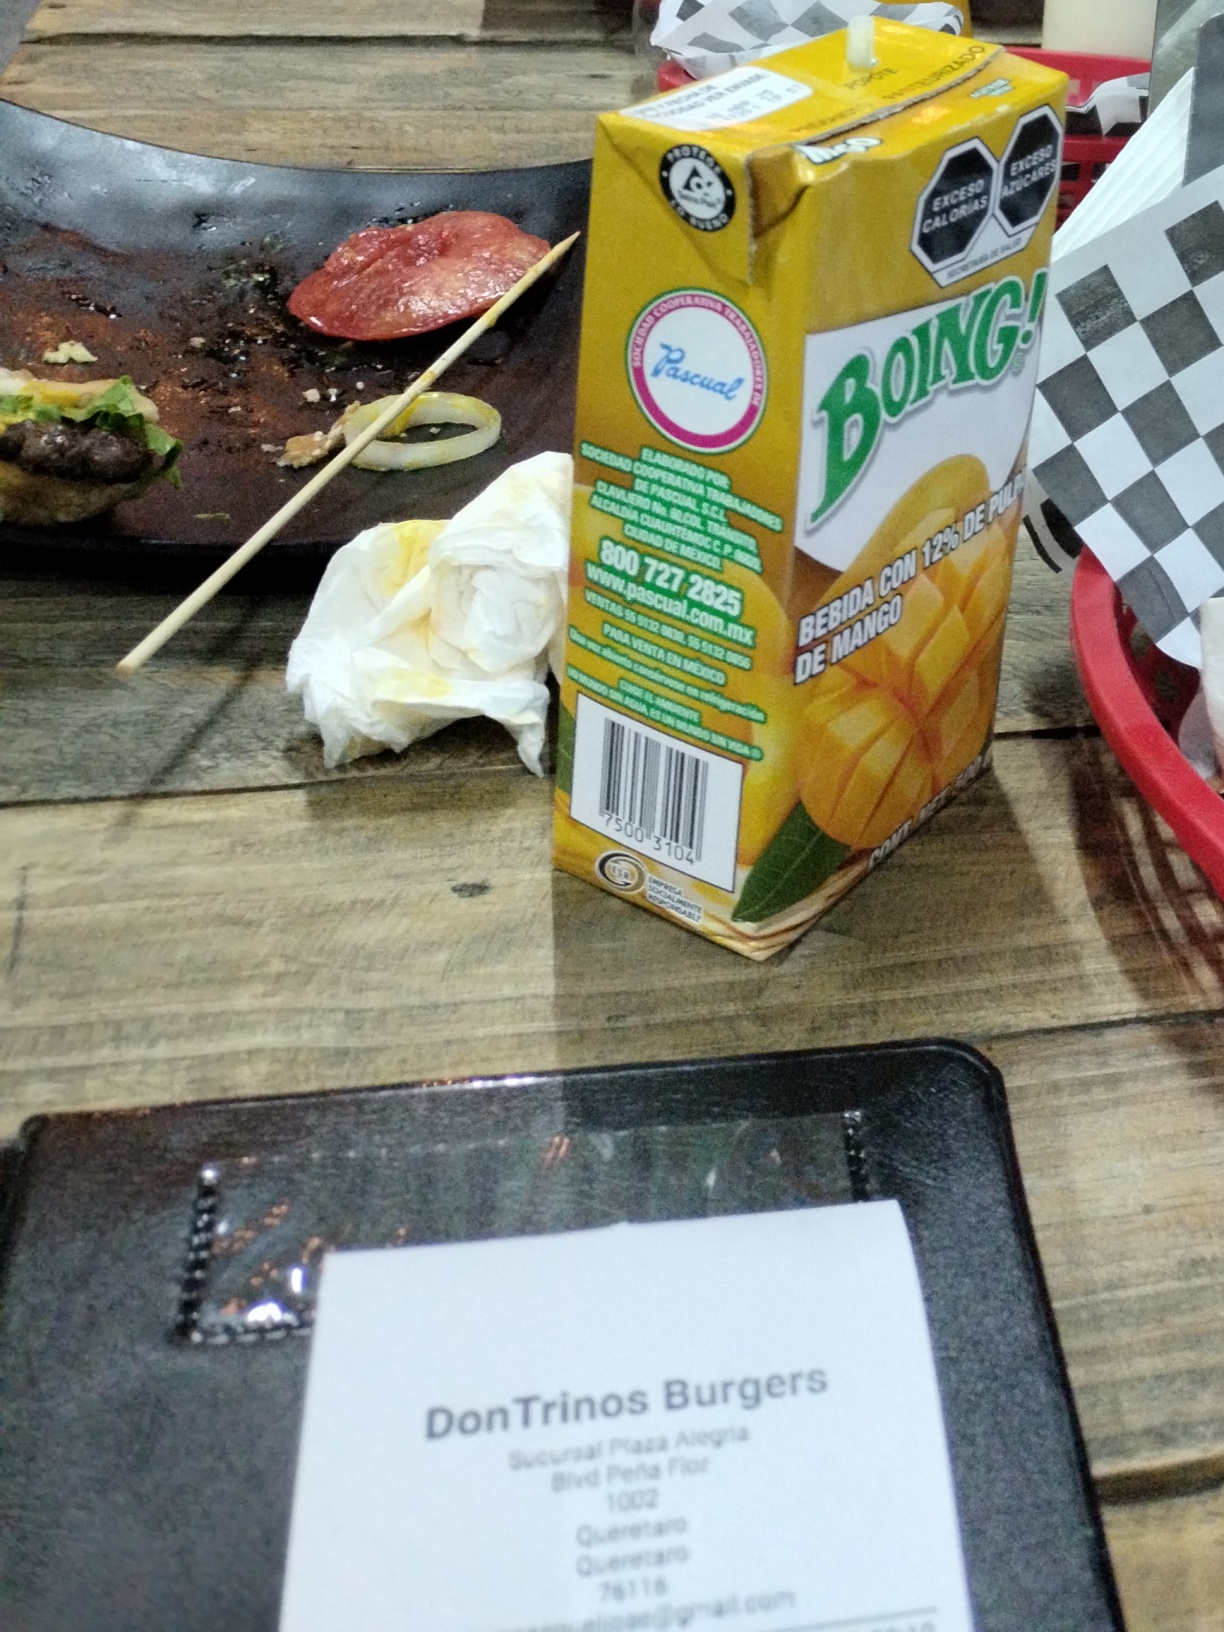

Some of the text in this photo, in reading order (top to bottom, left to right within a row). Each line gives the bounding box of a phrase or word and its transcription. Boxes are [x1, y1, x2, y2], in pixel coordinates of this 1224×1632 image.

[1001, 158, 1058, 197] AZÚCARES
[1010, 144, 1053, 176] EXCESO
[922, 195, 989, 234] CALORÍAS
[932, 179, 985, 212] EXCESO
[650, 342, 745, 401] Pascual
[809, 268, 1049, 524] BOING!
[581, 442, 632, 473] SOCIEDAD
[600, 537, 743, 619] 800 727 2825
[797, 576, 875, 648] BEBIDA
[878, 547, 918, 599] CON
[921, 522, 961, 570] 12%
[962, 504, 986, 543] DE
[586, 562, 755, 649] www.pascual.com.mx
[603, 622, 630, 647] PARA
[631, 634, 666, 662] VENTA
[794, 592, 904, 686] DE MANGO
[601, 810, 695, 866] 7500 3104
[425, 1367, 829, 1442] DonTrinos Burgers
[508, 1438, 603, 1471] Sucursal
[608, 1431, 669, 1458] Plaza
[550, 1469, 600, 1494] Blvd
[667, 1454, 711, 1476] Flor
[605, 1489, 659, 1515] 1002
